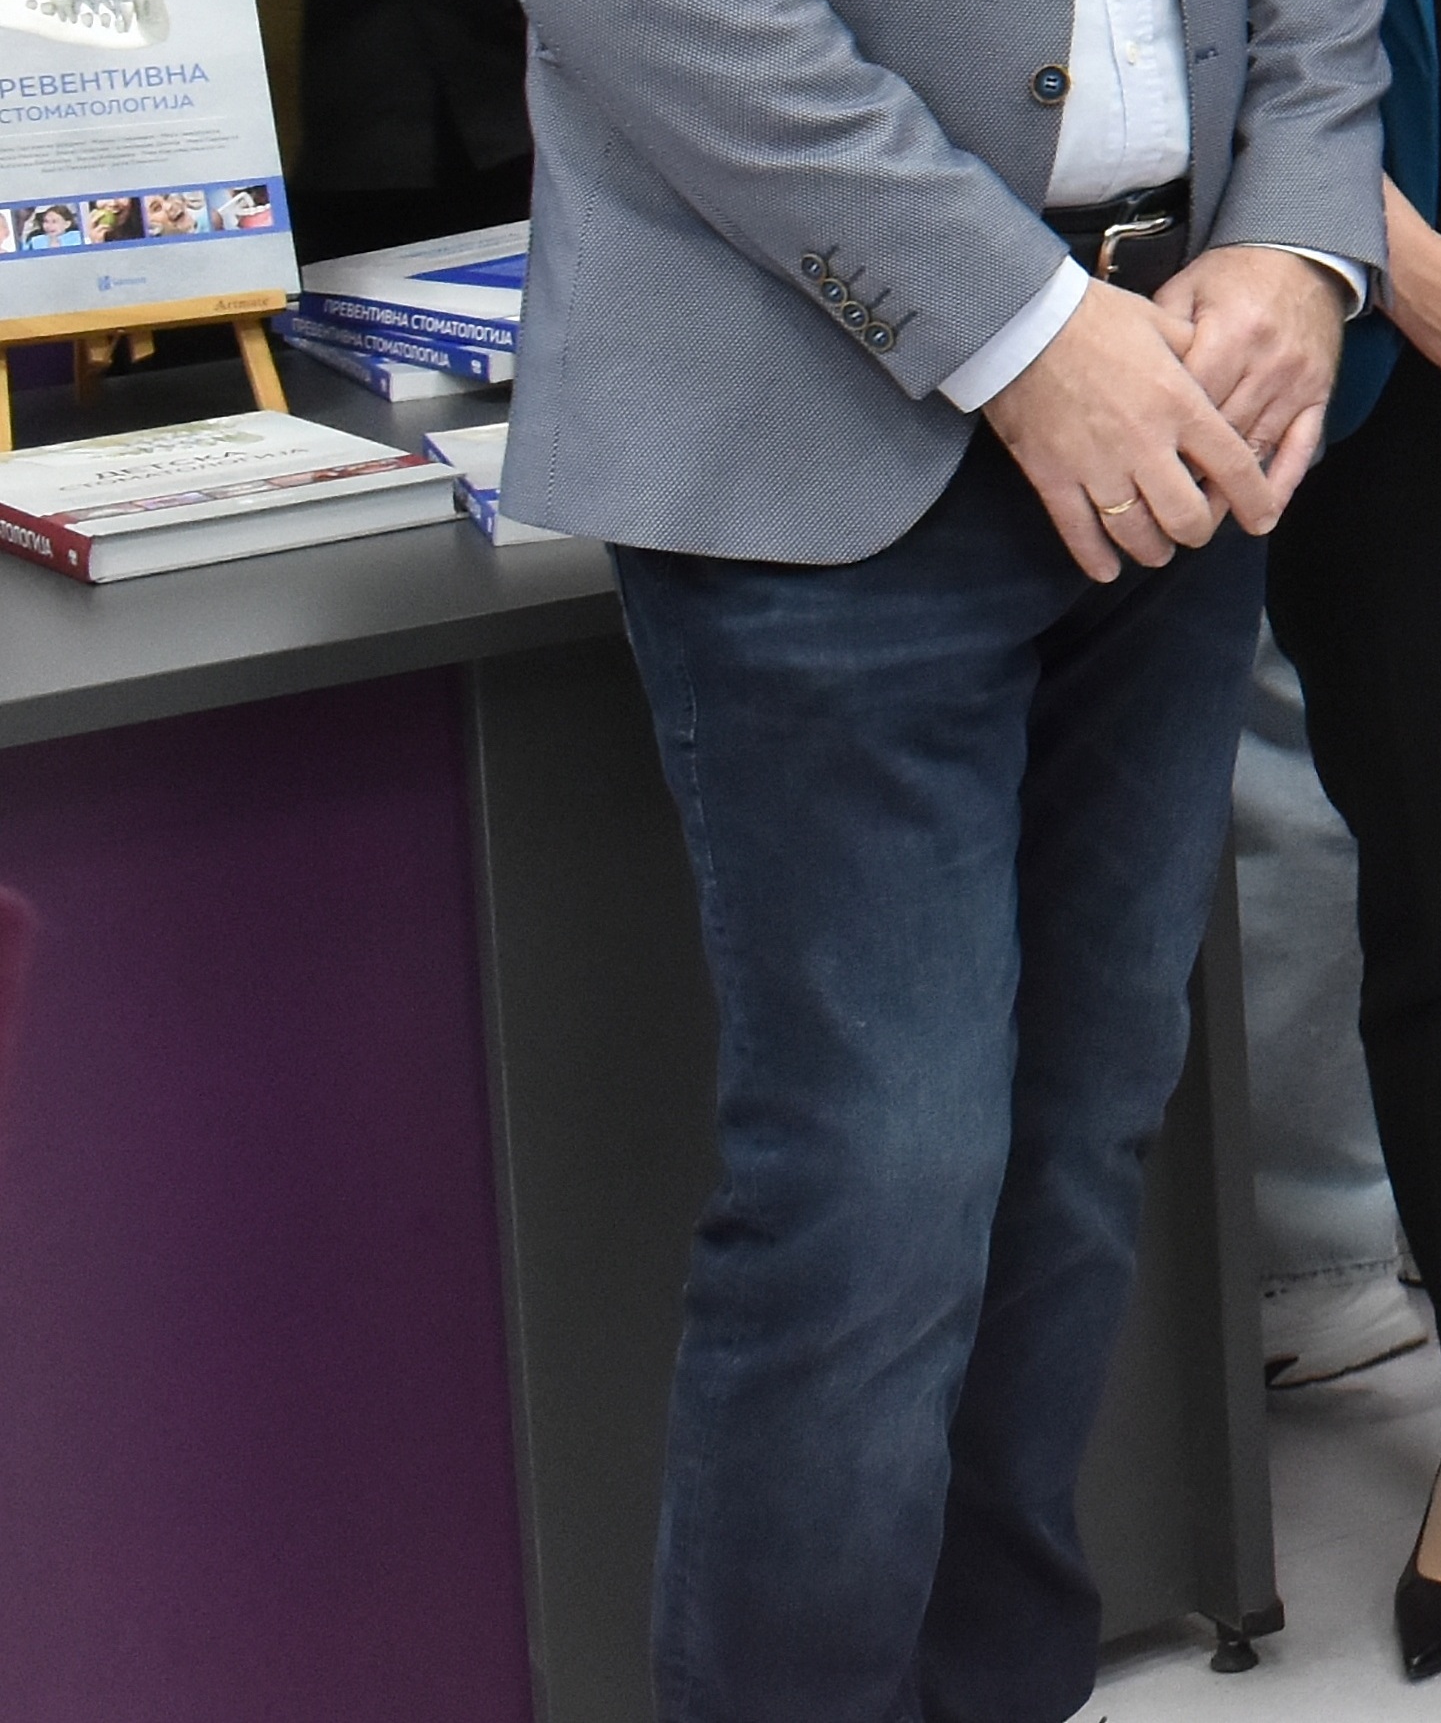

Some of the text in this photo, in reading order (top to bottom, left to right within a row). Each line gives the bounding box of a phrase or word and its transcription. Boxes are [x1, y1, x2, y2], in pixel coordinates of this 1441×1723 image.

[0, 94, 195, 124] СТОМАТОЛОГИЈА
[324, 299, 513, 346] ПРЕВЕНТИВНА СТОМАТОЛОГИЈА
